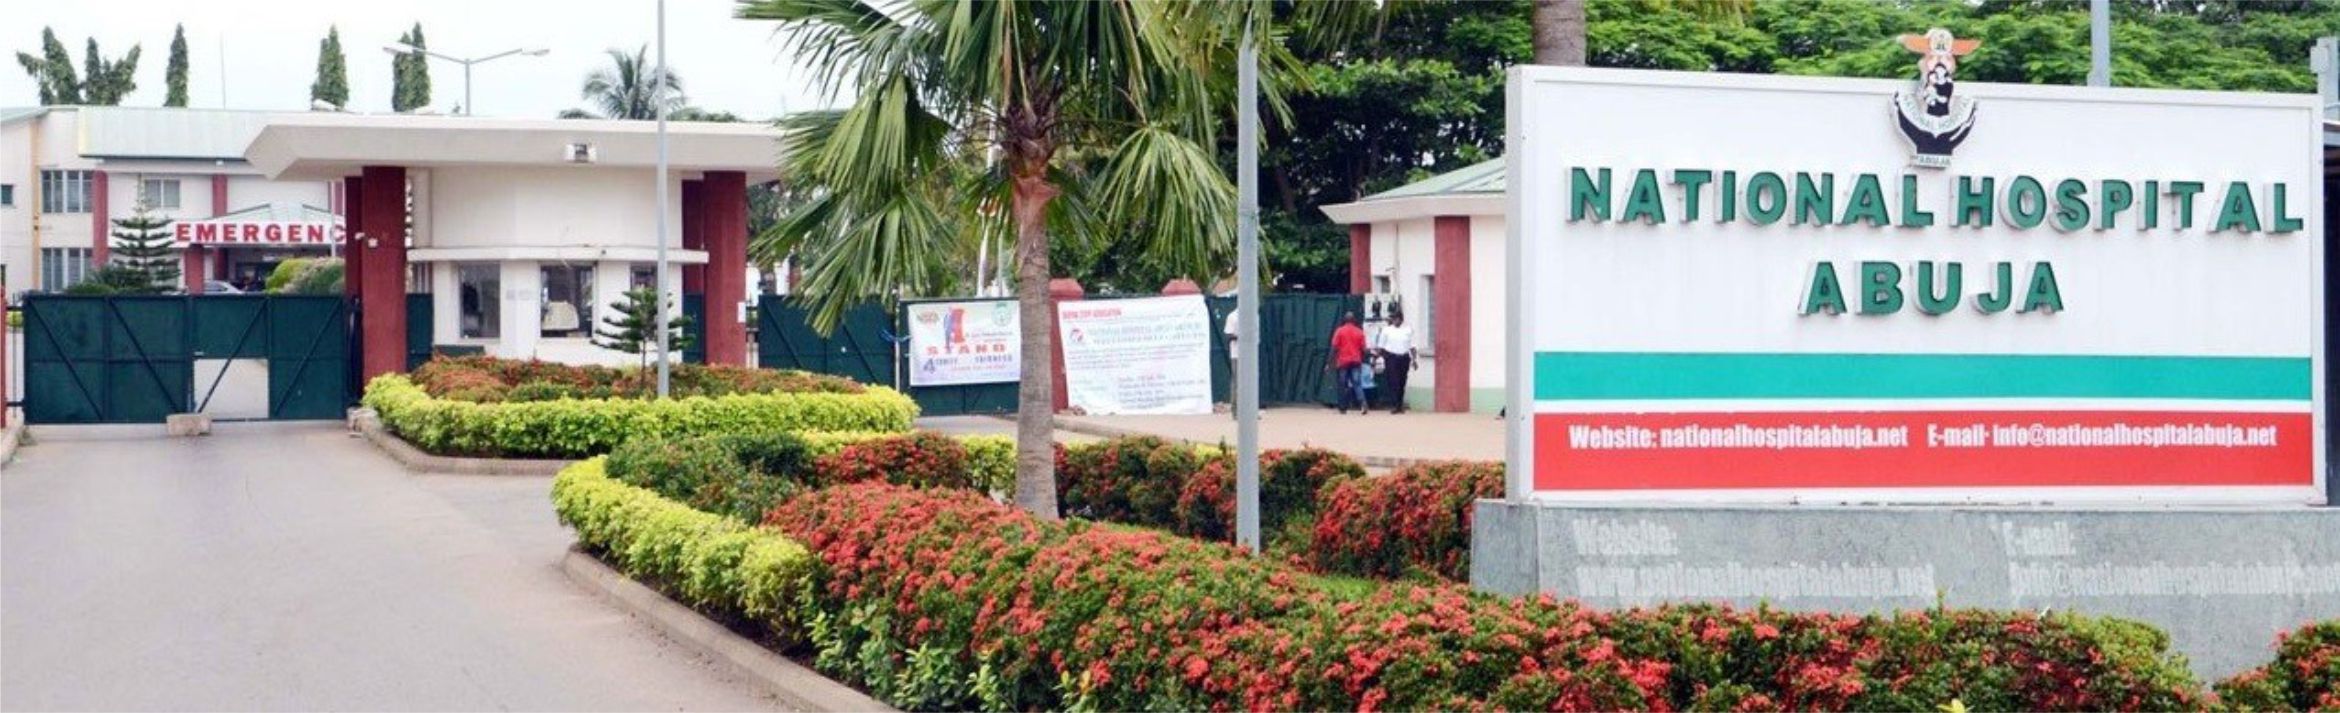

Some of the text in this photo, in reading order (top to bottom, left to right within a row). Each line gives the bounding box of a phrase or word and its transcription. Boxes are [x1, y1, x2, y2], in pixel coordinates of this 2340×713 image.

[1566, 166, 2304, 235] NATIONAL HOSPITAL
[175, 223, 346, 243] EMERGENC
[1799, 260, 2064, 317] ABUJA
[1569, 424, 1908, 449] Website: nationalhospitalabuja.net
[1993, 423, 2277, 448] info@nationalhospitalabuja.net
